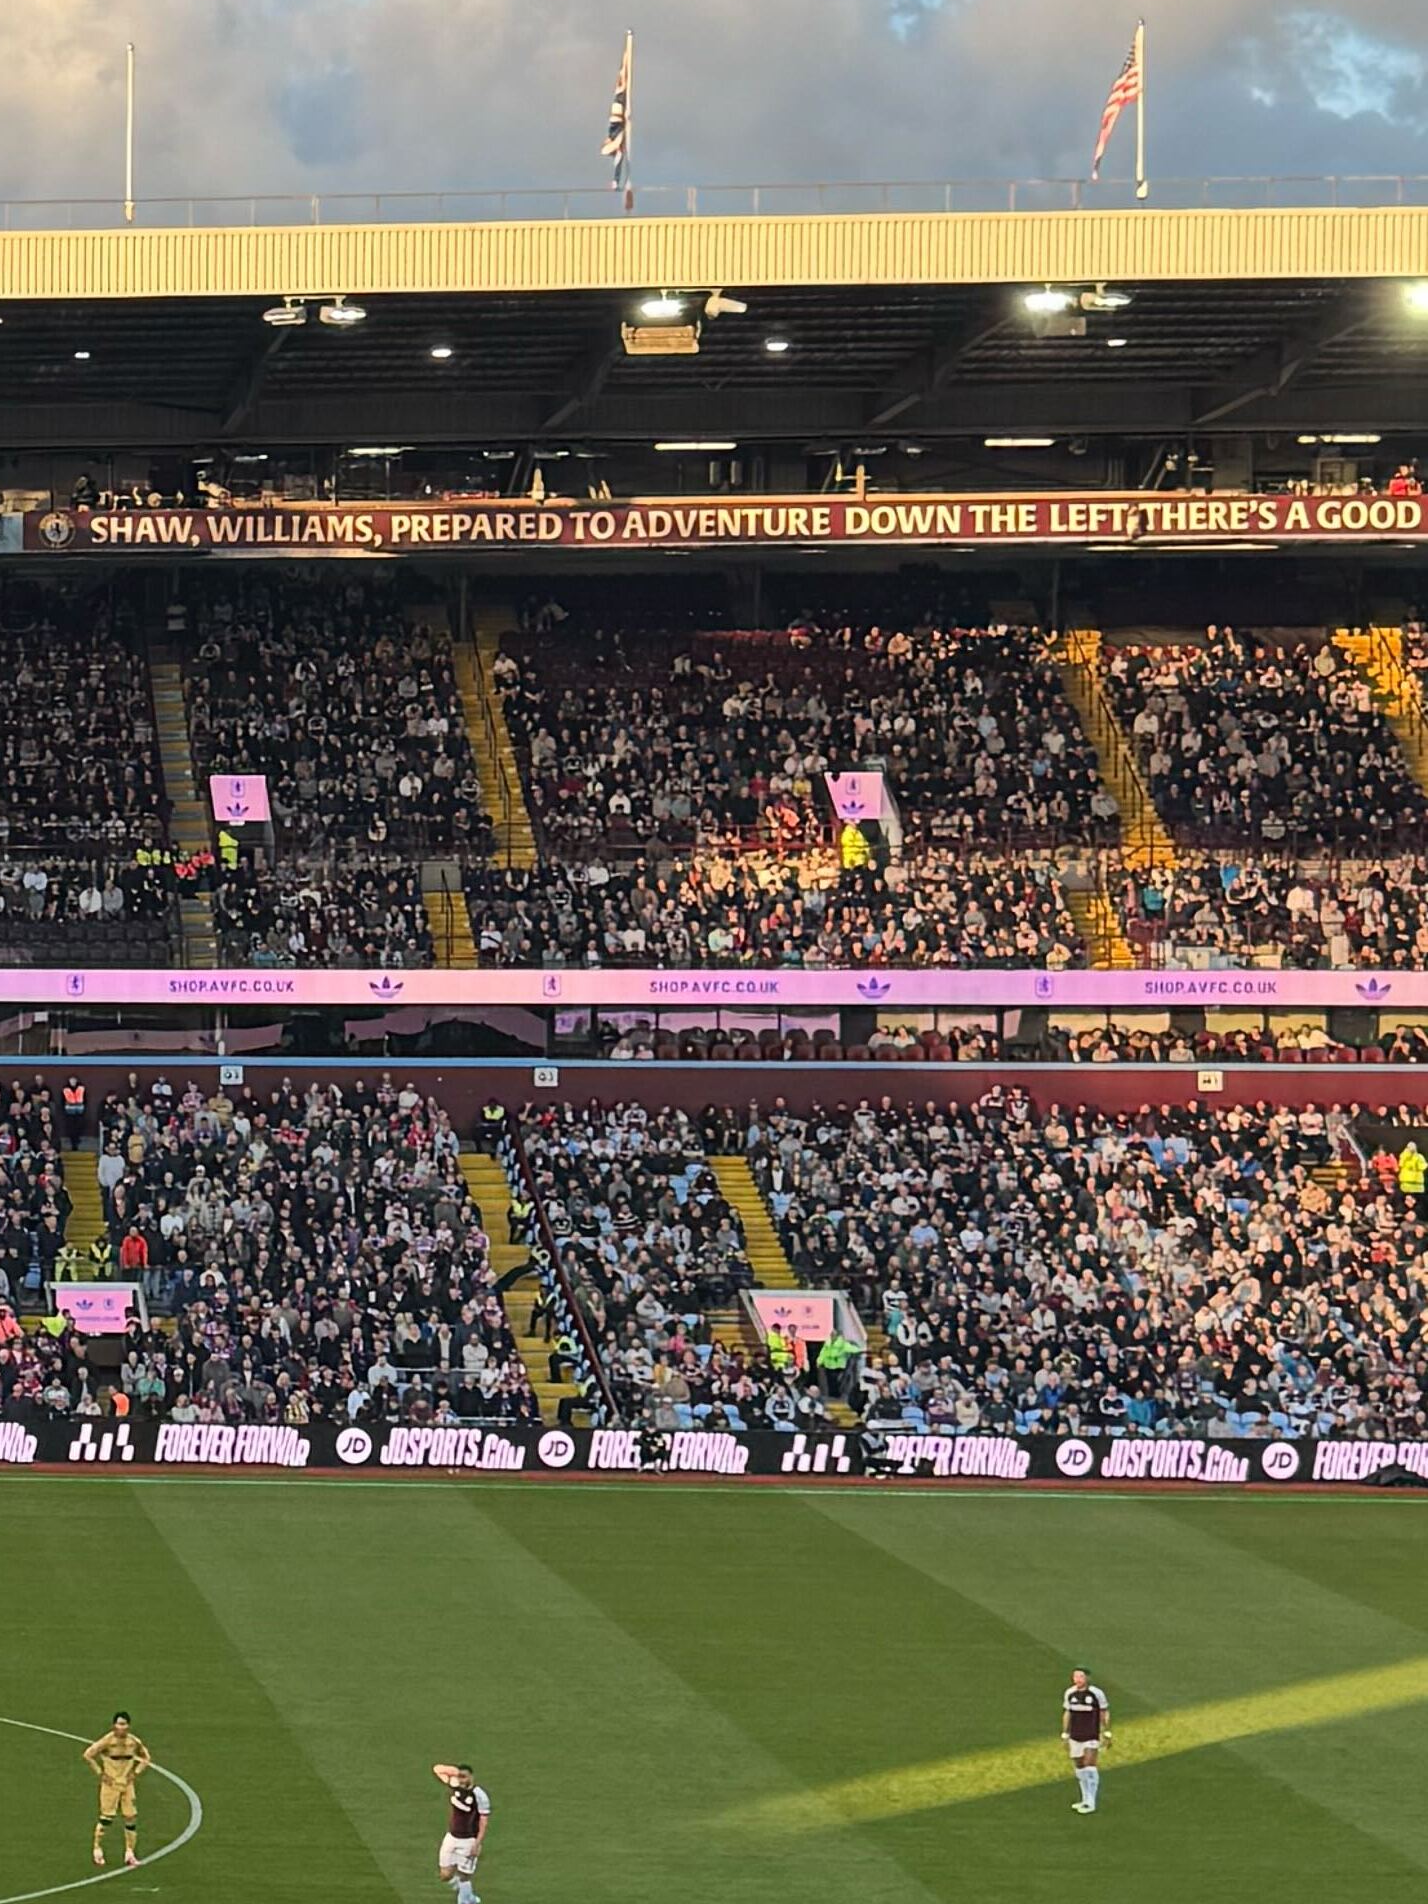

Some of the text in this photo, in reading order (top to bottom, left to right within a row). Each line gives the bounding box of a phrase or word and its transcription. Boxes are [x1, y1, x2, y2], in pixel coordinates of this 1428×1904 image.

[90, 514, 201, 547] SHAW,
[207, 512, 383, 548] WILLIAMS,
[391, 510, 562, 543] PREPARED
[569, 509, 616, 540] TO
[622, 506, 831, 539] ADVENTURE
[846, 504, 960, 536] DOWN
[968, 503, 1037, 534] THE
[1141, 500, 1277, 531] THERE'S
[1284, 501, 1311, 530] A
[1316, 499, 1422, 530] GOOD
[1145, 979, 1277, 995] SHOP.AVFC.CO.UK
[154, 1424, 238, 1464] FOREVER
[343, 1436, 366, 1453] JD
[544, 1440, 567, 1457] JD
[1062, 1448, 1087, 1466] JD
[1267, 1450, 1291, 1468] JD
